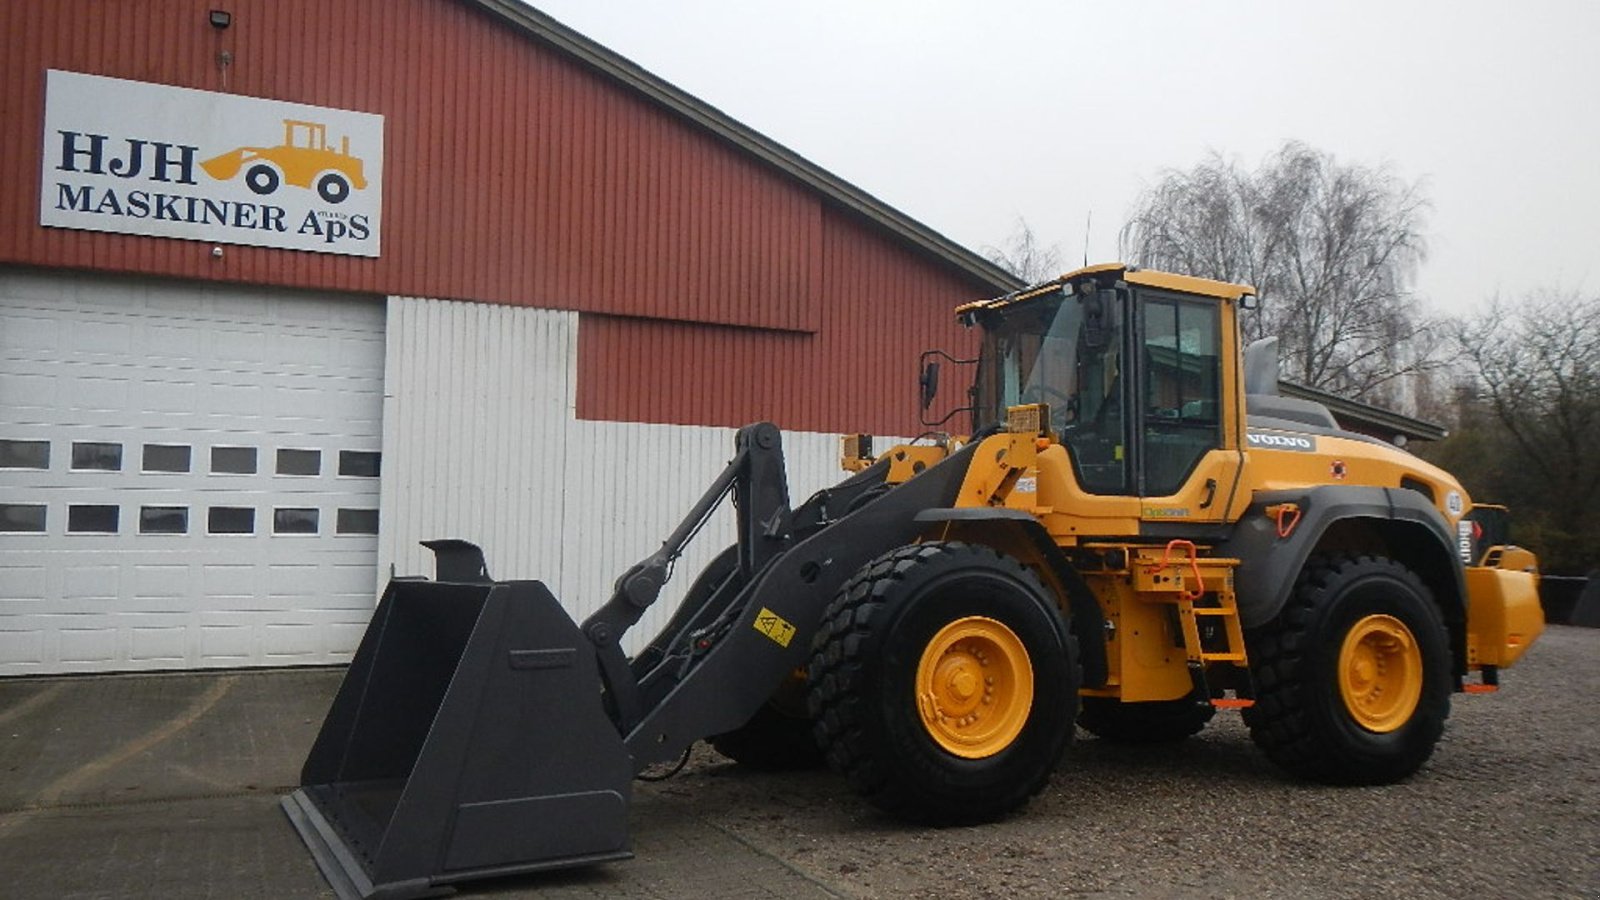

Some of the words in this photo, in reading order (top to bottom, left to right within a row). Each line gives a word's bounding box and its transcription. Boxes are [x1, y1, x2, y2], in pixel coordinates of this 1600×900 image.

[56, 130, 199, 185] HJH
[55, 183, 288, 232] MASKINER
[297, 209, 370, 243] ApS
[1246, 433, 1311, 449] VOLVO
